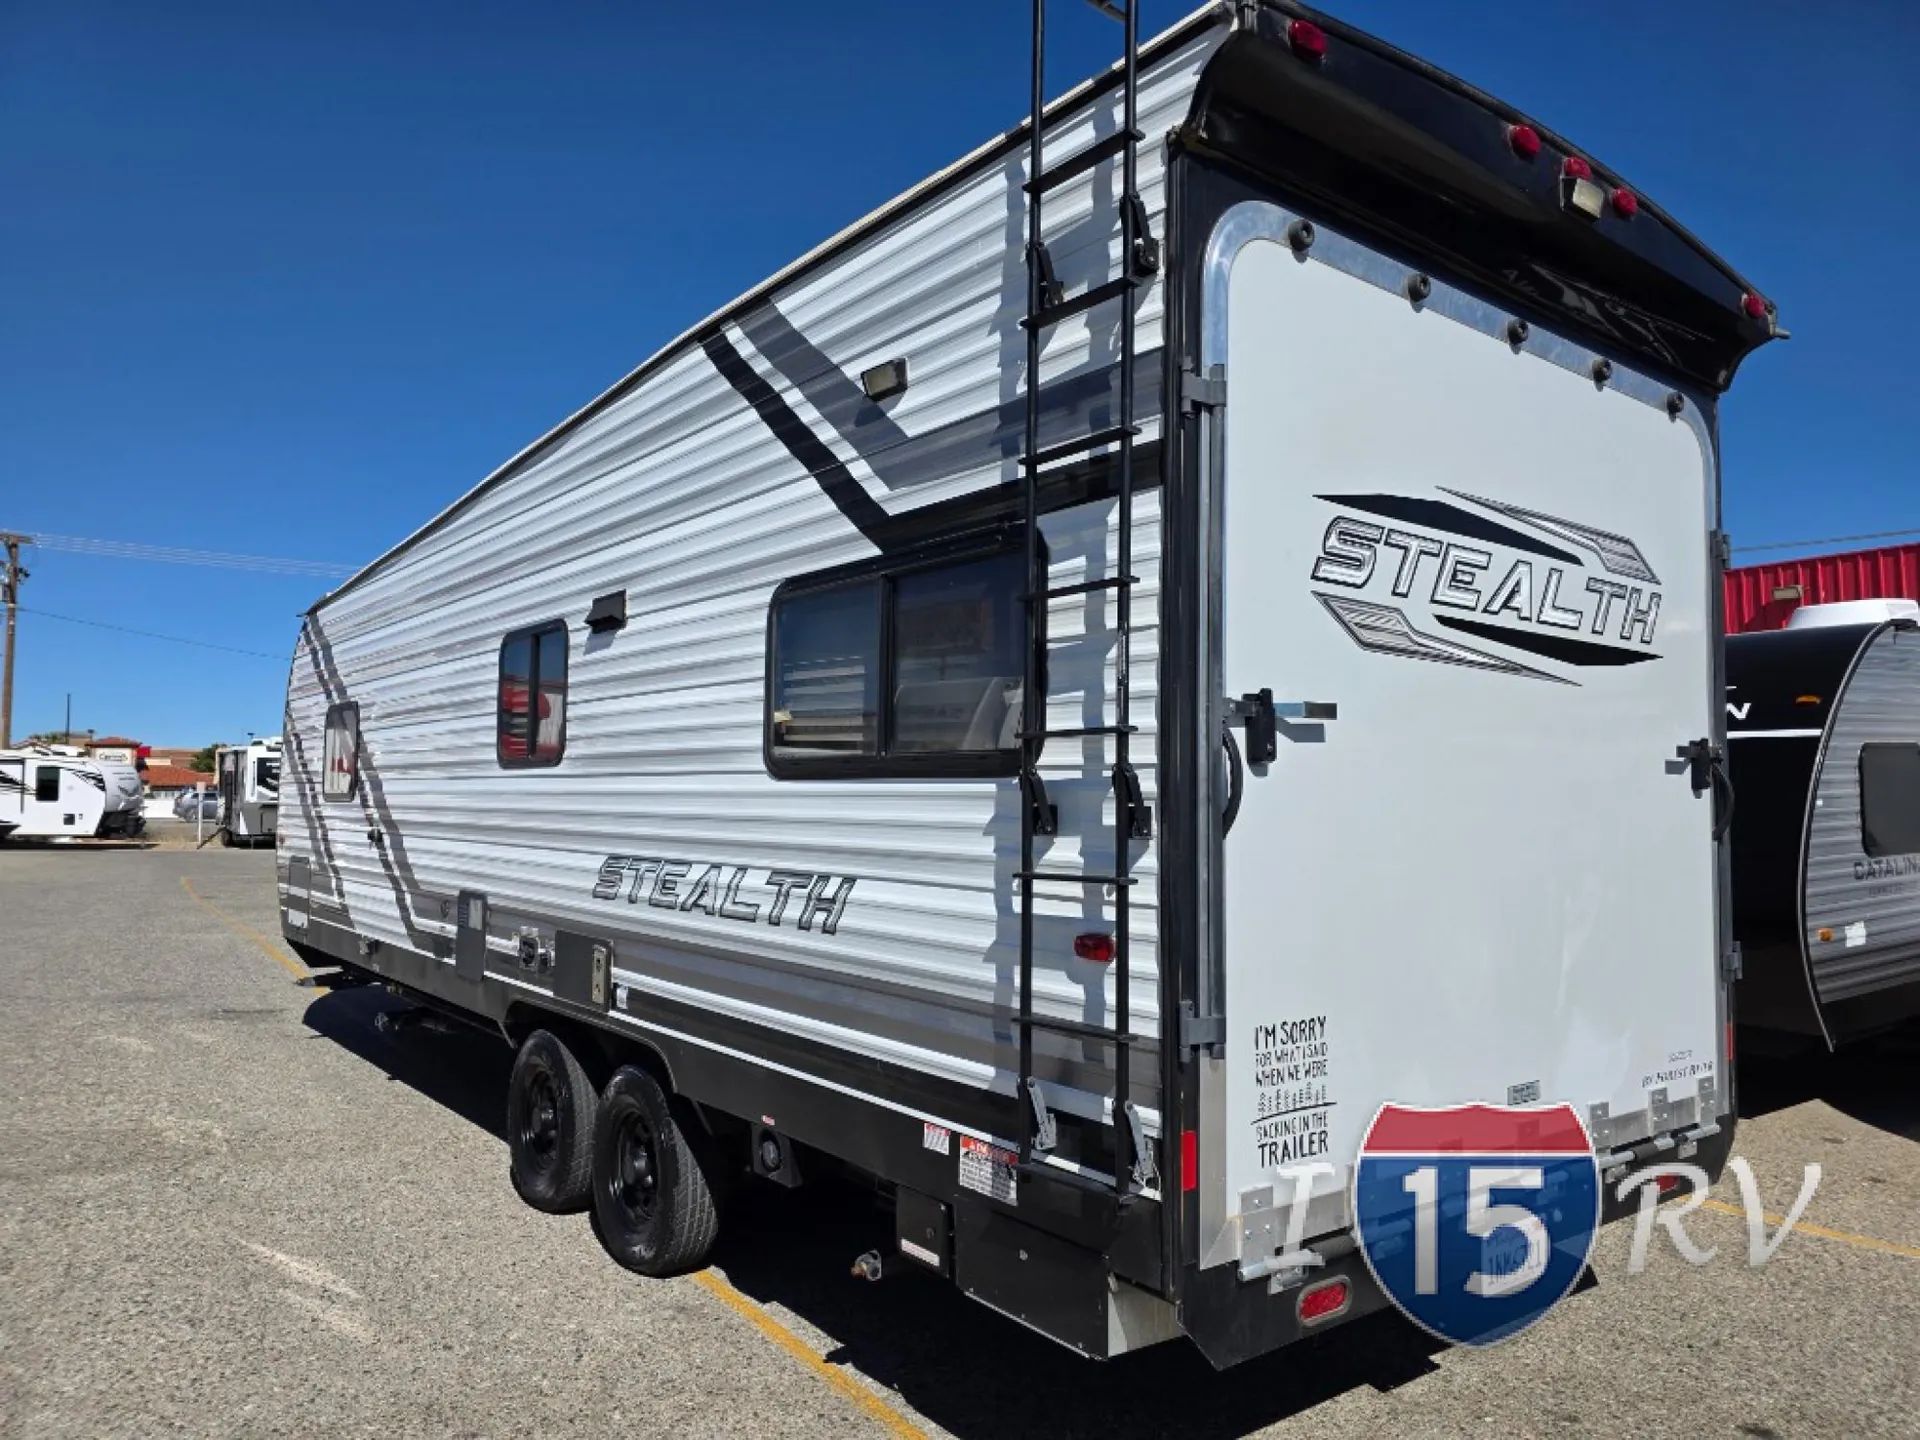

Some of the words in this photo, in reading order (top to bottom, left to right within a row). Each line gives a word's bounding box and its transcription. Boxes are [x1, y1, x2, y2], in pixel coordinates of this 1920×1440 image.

[1310, 515, 1662, 643] STEALTH
[1854, 856, 1920, 880] CATALIN
[592, 854, 857, 935] STEALTH
[1254, 1023, 1276, 1050] I'M
[1280, 1015, 1327, 1045] SORRY
[1255, 1067, 1285, 1088] WHEN
[1258, 1130, 1329, 1168] TRAILER
